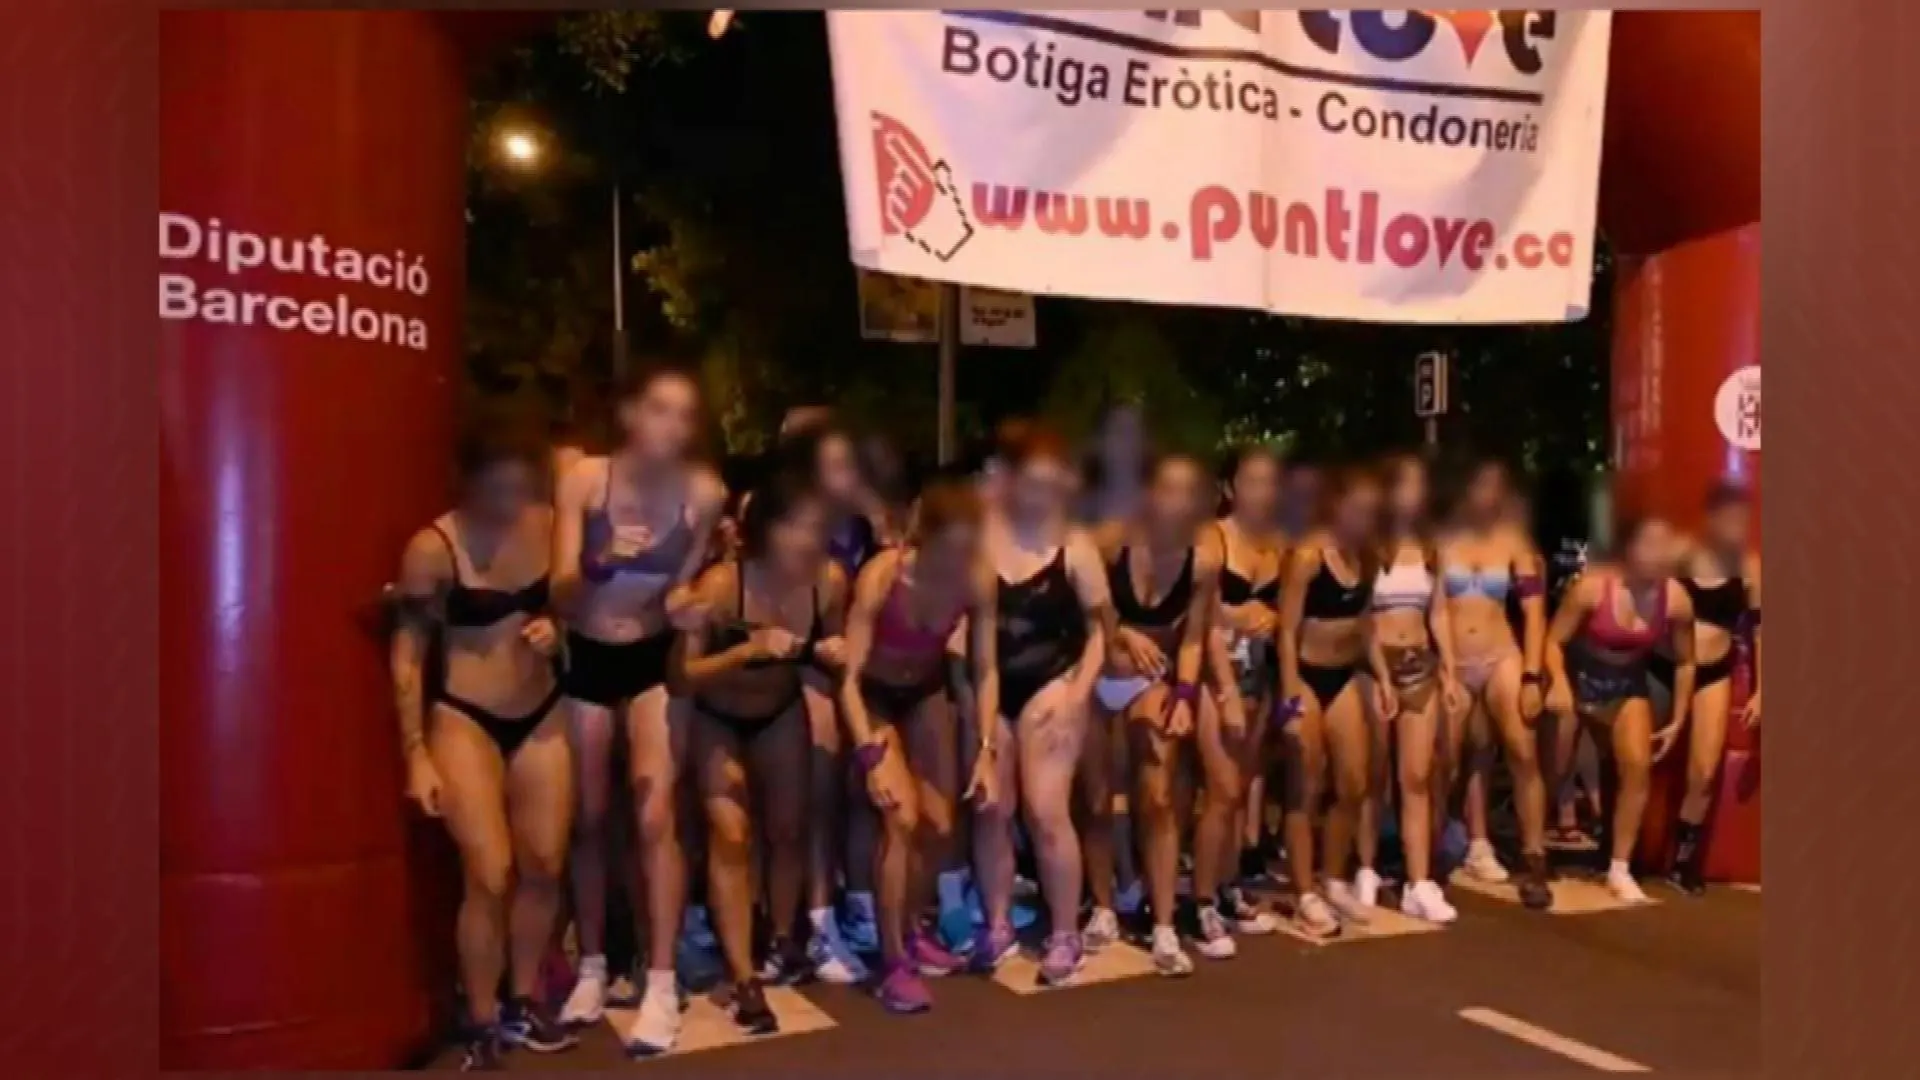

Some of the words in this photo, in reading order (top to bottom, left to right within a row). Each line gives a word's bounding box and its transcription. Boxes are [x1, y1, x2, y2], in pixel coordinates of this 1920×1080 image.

[941, 25, 1110, 106] Botiga
[1122, 59, 1278, 120] Eròtica
[1317, 91, 1540, 152] Condoneria
[159, 212, 429, 296] Diputació
[159, 274, 428, 350] Barcelona
